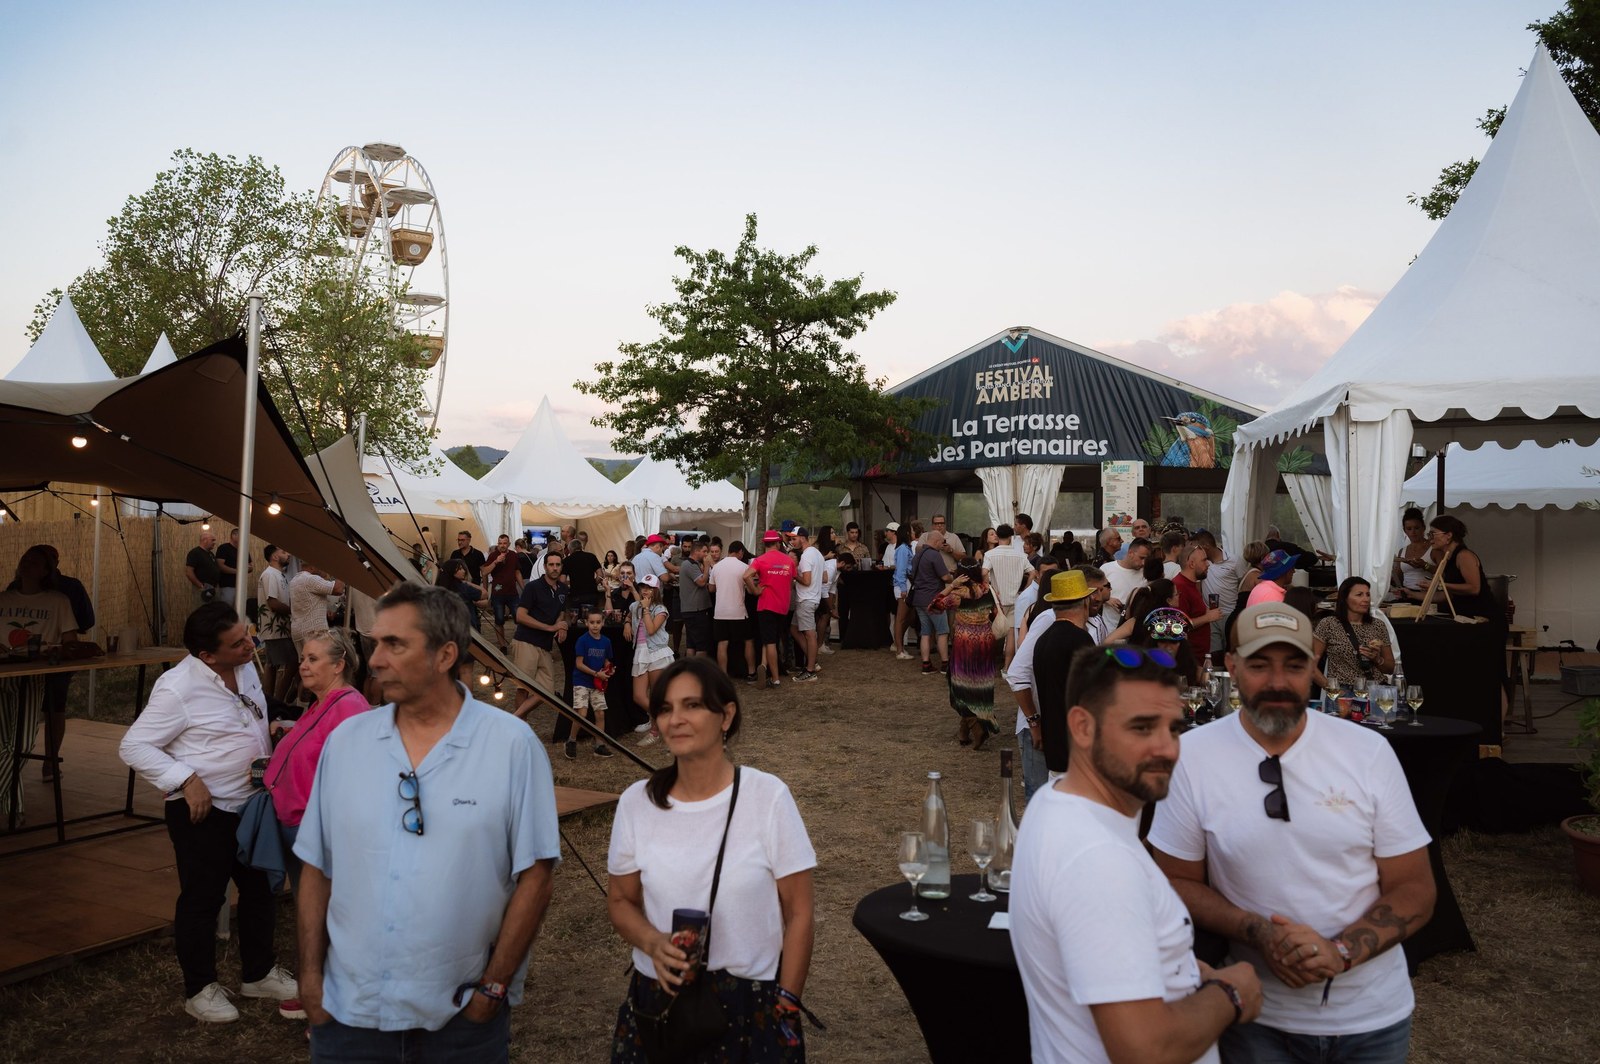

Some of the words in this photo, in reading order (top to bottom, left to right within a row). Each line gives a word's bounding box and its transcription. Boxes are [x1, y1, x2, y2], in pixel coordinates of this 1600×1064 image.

[976, 365, 1053, 388] FESTIVAL
[976, 382, 1053, 404] AMBERT
[952, 419, 977, 437] La
[983, 414, 1080, 433] Terrasse
[929, 443, 965, 463] des
[970, 435, 1108, 459] Partenaires
[370, 496, 403, 505] LLIA
[0, 607, 12, 617] LA
[15, 604, 49, 620] PÊCHE
